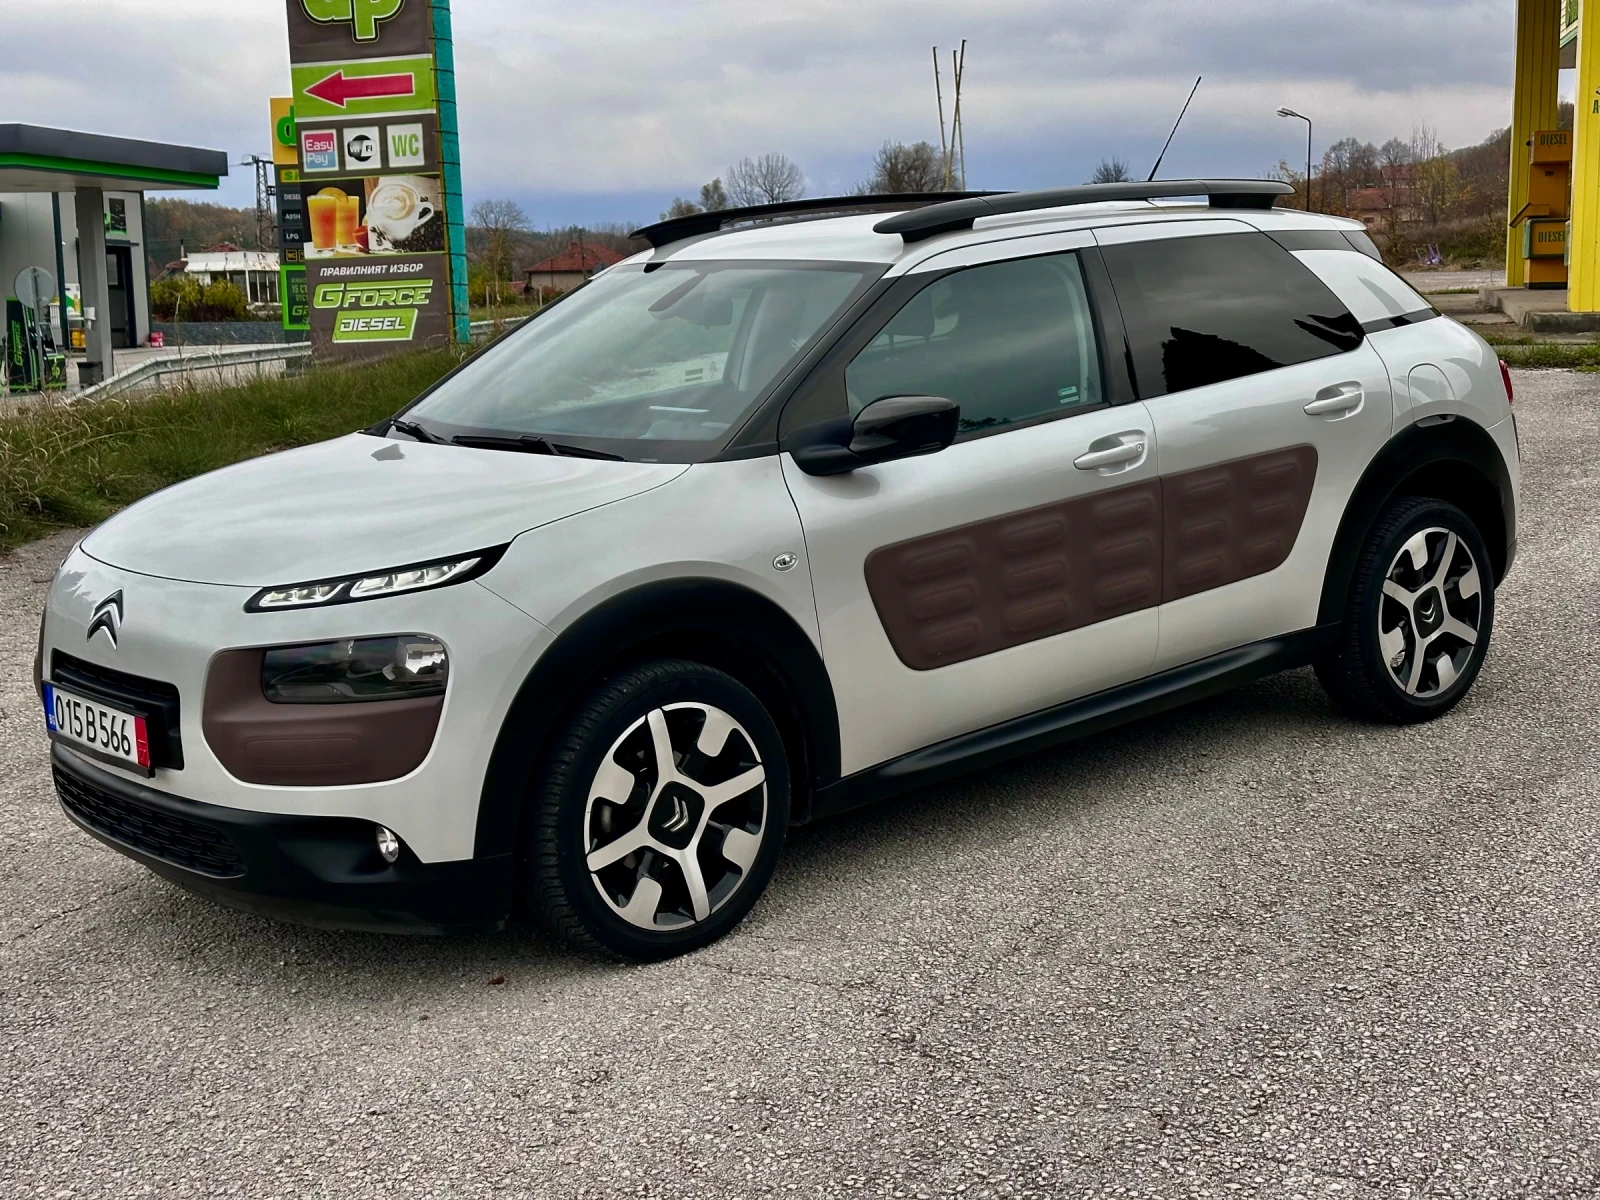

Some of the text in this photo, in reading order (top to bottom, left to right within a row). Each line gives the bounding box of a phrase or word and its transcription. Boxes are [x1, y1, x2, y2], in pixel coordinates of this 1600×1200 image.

[305, 139, 334, 153] Easy
[391, 133, 419, 157] WC
[1540, 133, 1567, 145] DIESEL
[306, 152, 329, 166] Pay
[320, 263, 423, 277] ПРАВИЛНИЯТ ИЗБОР
[340, 317, 406, 331] DIESEL
